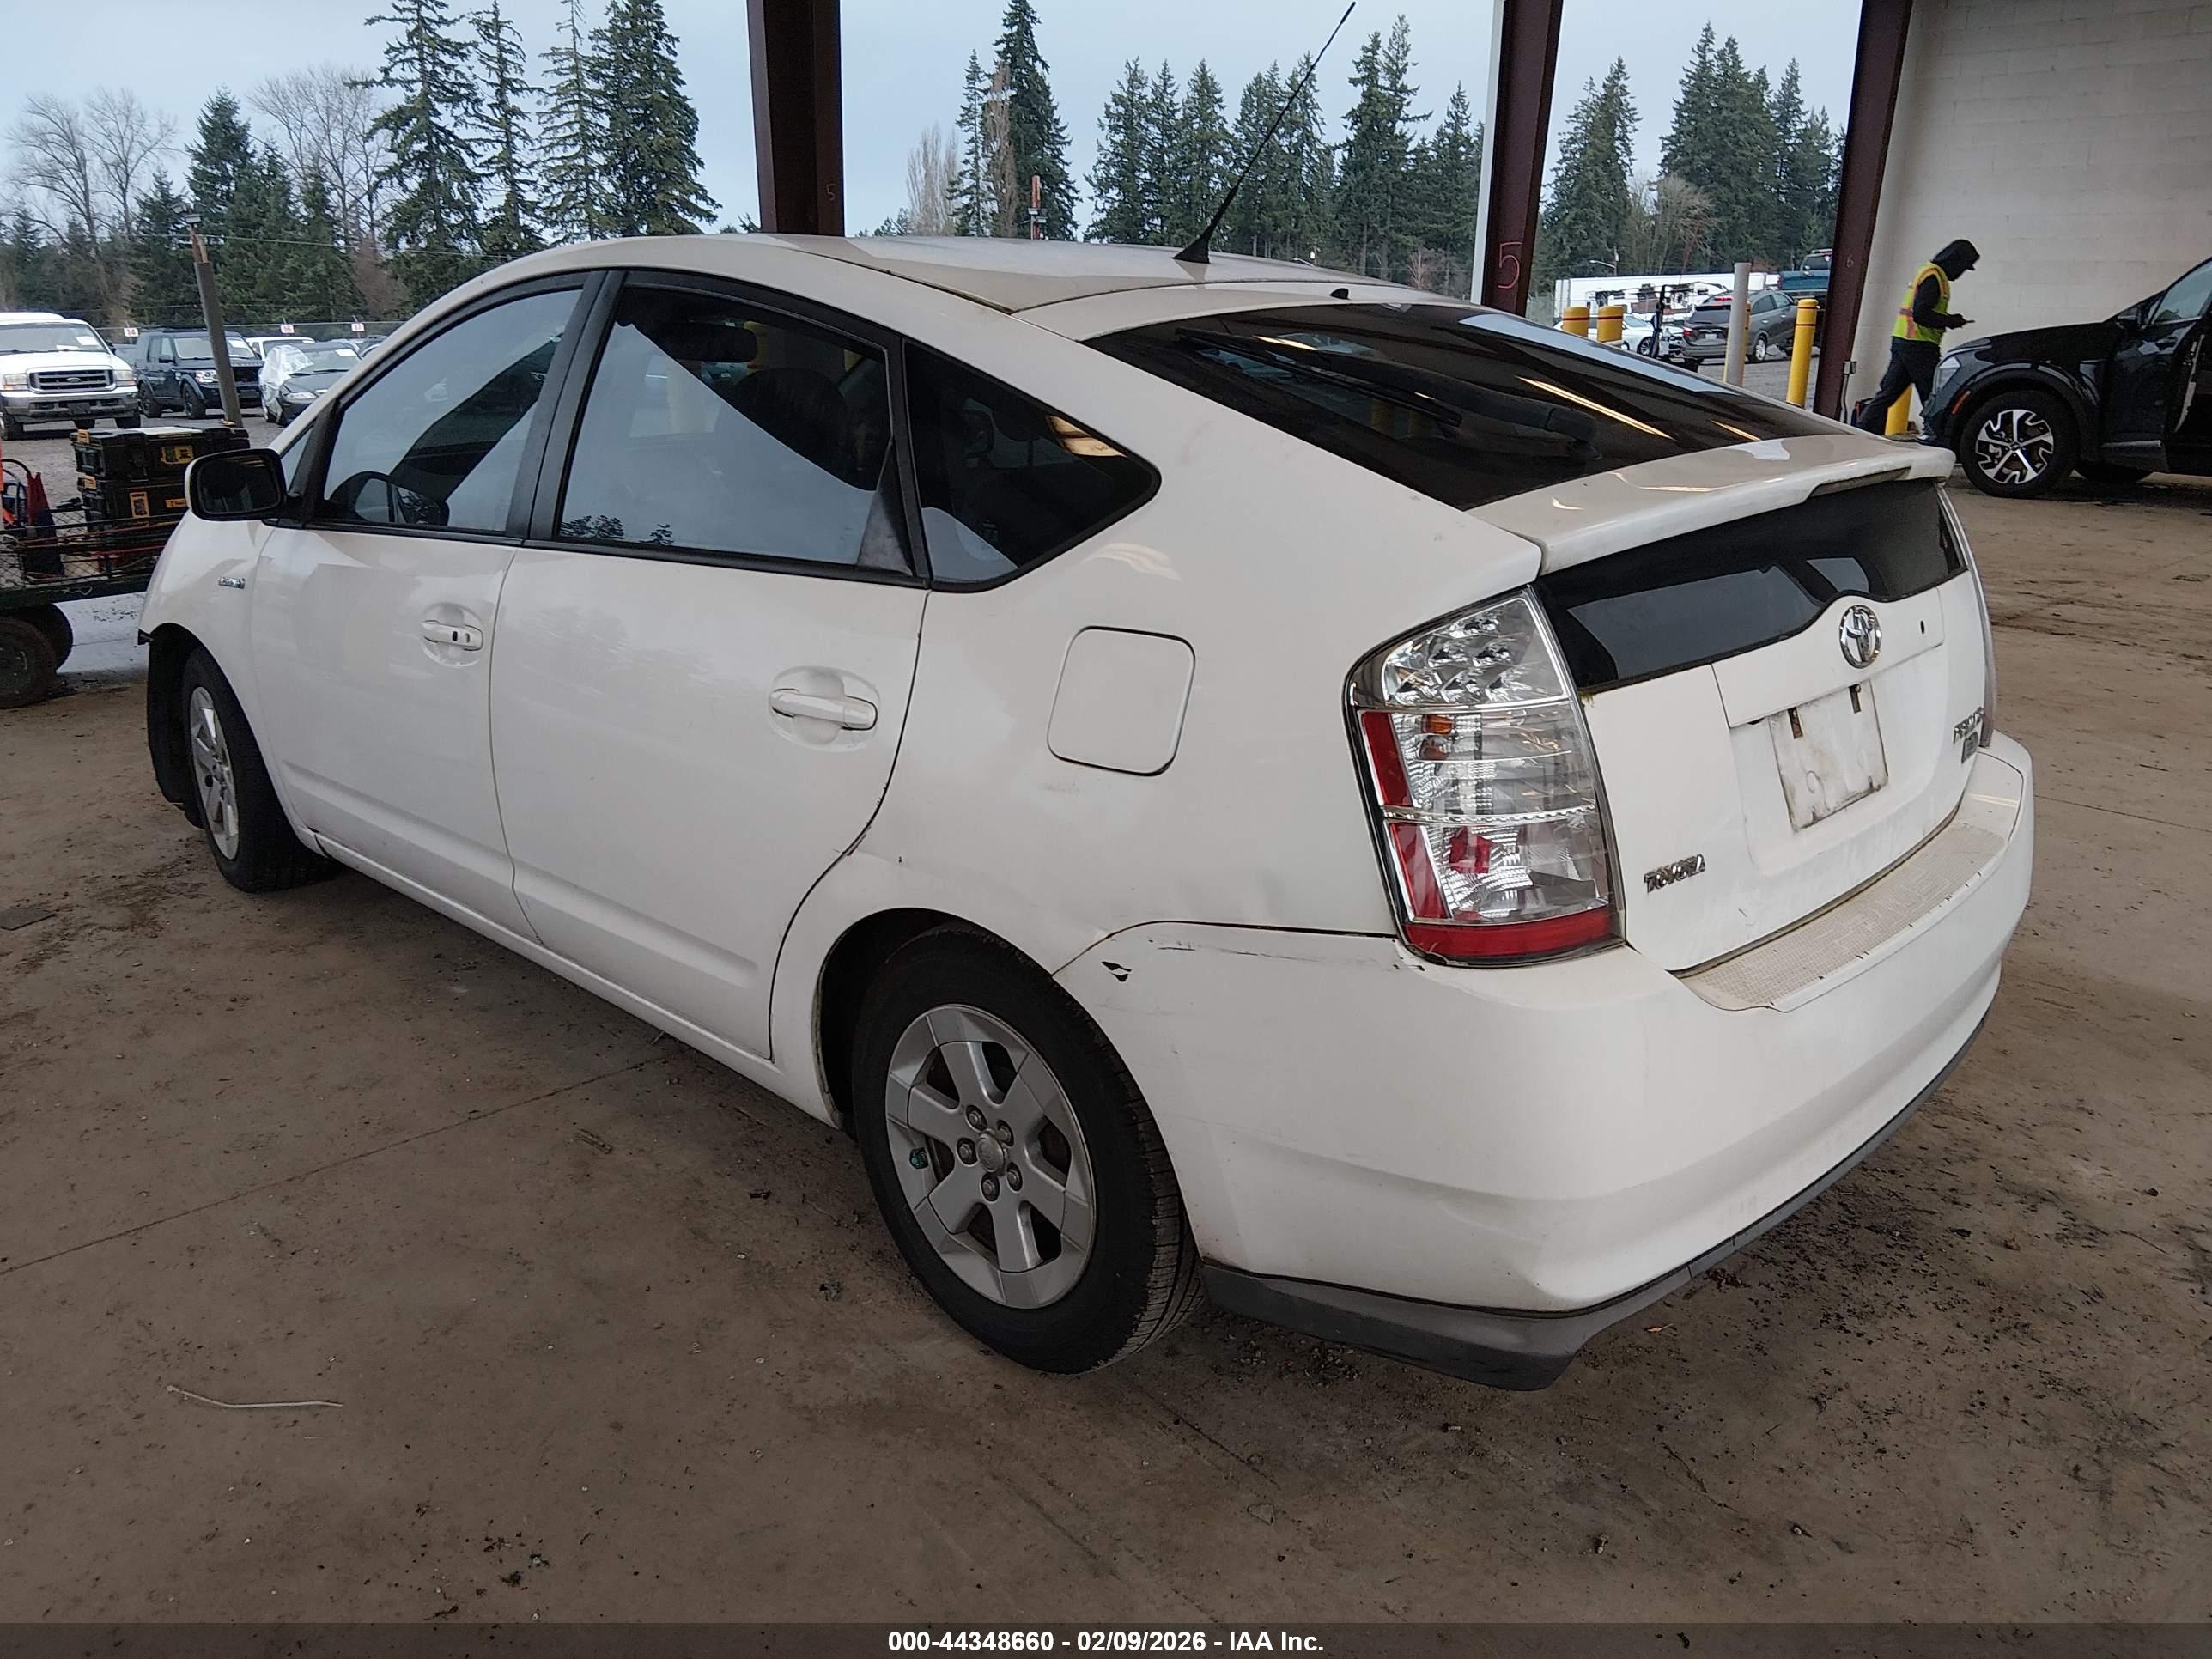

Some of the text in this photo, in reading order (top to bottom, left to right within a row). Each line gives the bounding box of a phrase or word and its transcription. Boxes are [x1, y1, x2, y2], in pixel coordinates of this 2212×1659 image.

[826, 183, 838, 201] 5
[1498, 241, 1524, 289] 5
[1644, 854, 1706, 894] TOYOTA
